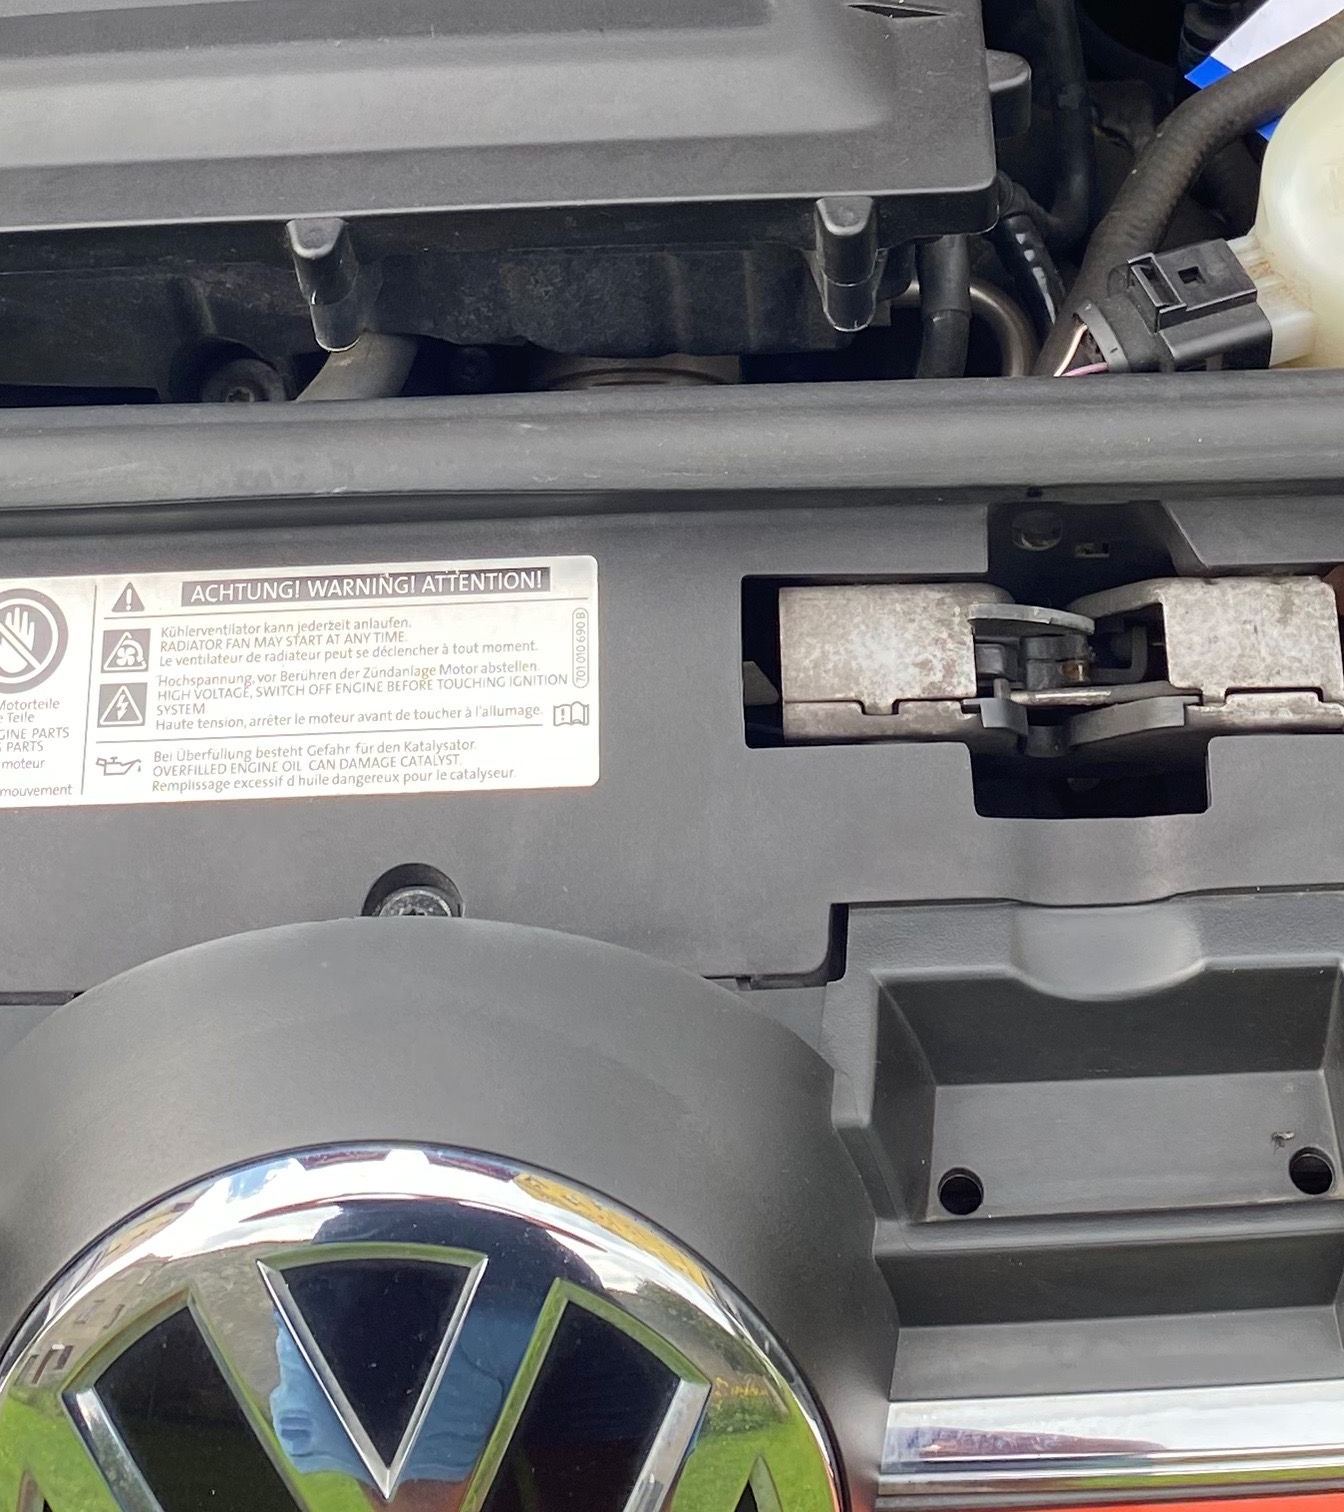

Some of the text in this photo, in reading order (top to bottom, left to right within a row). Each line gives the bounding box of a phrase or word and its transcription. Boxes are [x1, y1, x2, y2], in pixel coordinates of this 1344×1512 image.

[190, 570, 542, 603] ACHTUNG! WARNING! ATTENTION!
[575, 611, 586, 619] B
[160, 616, 412, 638] Kühlerventilator kann jederzeit anlaufen.
[575, 621, 586, 643] 690
[160, 631, 407, 652] RADIATOR FAN MAY START AT ANY TIME.
[159, 640, 538, 667] Le ventilateur de radiateur peut se déclencher à tout moment.
[575, 645, 586, 665] 010
[158, 660, 540, 688] Hochspannung, vor Berühren der Zündanlage Motor abstellen.
[157, 674, 568, 701] HIGH VOLTAGE, SWITCH OFF ENGINE BEFORE TOUCHING IGNITION
[7, 711, 35, 723] Teile
[155, 704, 543, 731] Haute tension, arrêter le moteur avant de toucher à l'allumage.
[156, 703, 206, 716] SYSTEM
[32, 727, 69, 739] PARTS
[6, 740, 44, 752] PARTS
[153, 738, 475, 764] Bei Überfüllung besteht Gefahr für den Katalysator.
[1, 758, 45, 770] moteur
[152, 753, 462, 777] OVERFILLED ENGINE OIL CAN DAMAGE CATALYST.
[0, 784, 72, 797] mouvement
[152, 779, 230, 793] Remplissage
[233, 775, 282, 788] excessif
[332, 771, 400, 788] dangereux
[403, 770, 432, 786] pour
[436, 769, 447, 781] le
[449, 767, 516, 783] catalyseur.
